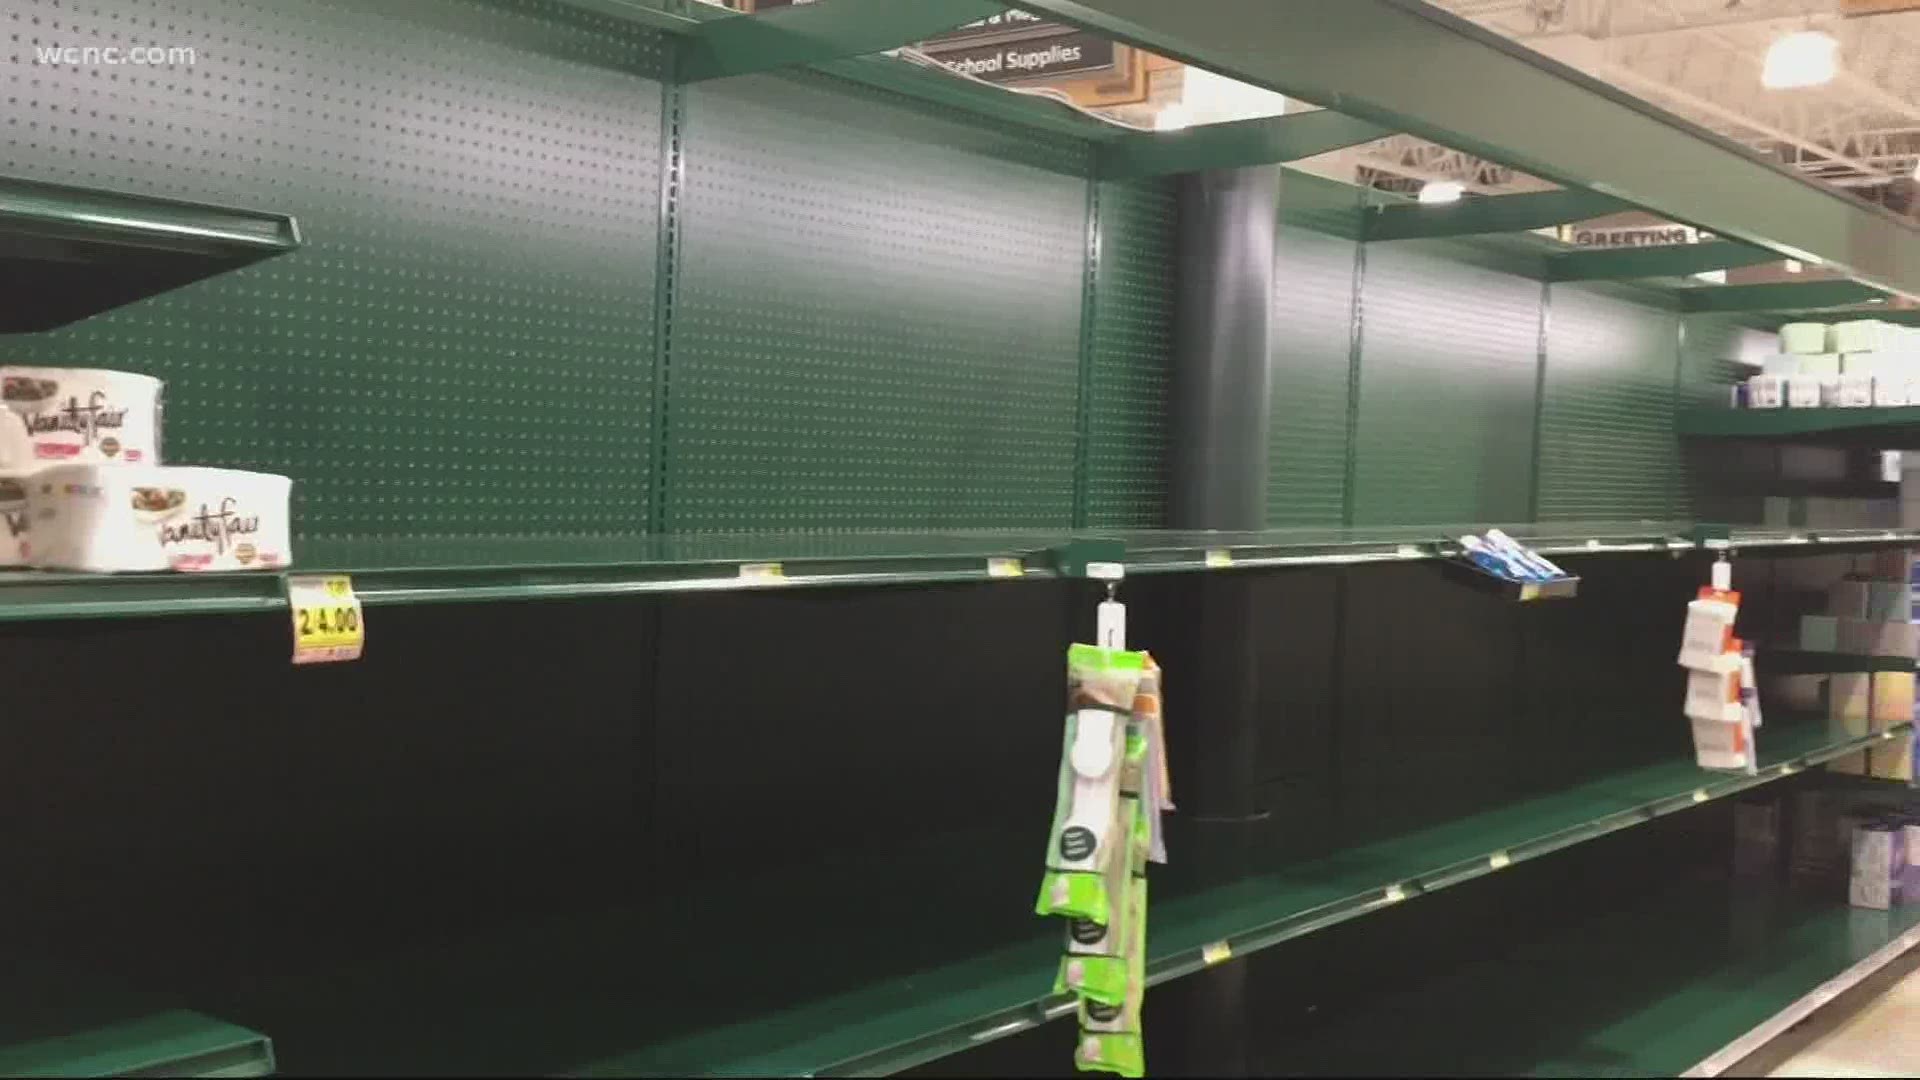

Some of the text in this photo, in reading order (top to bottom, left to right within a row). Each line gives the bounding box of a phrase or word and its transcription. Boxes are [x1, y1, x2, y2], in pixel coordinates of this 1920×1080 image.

[947, 46, 1081, 74] School Supplies
[1576, 229, 1687, 246] GREETING
